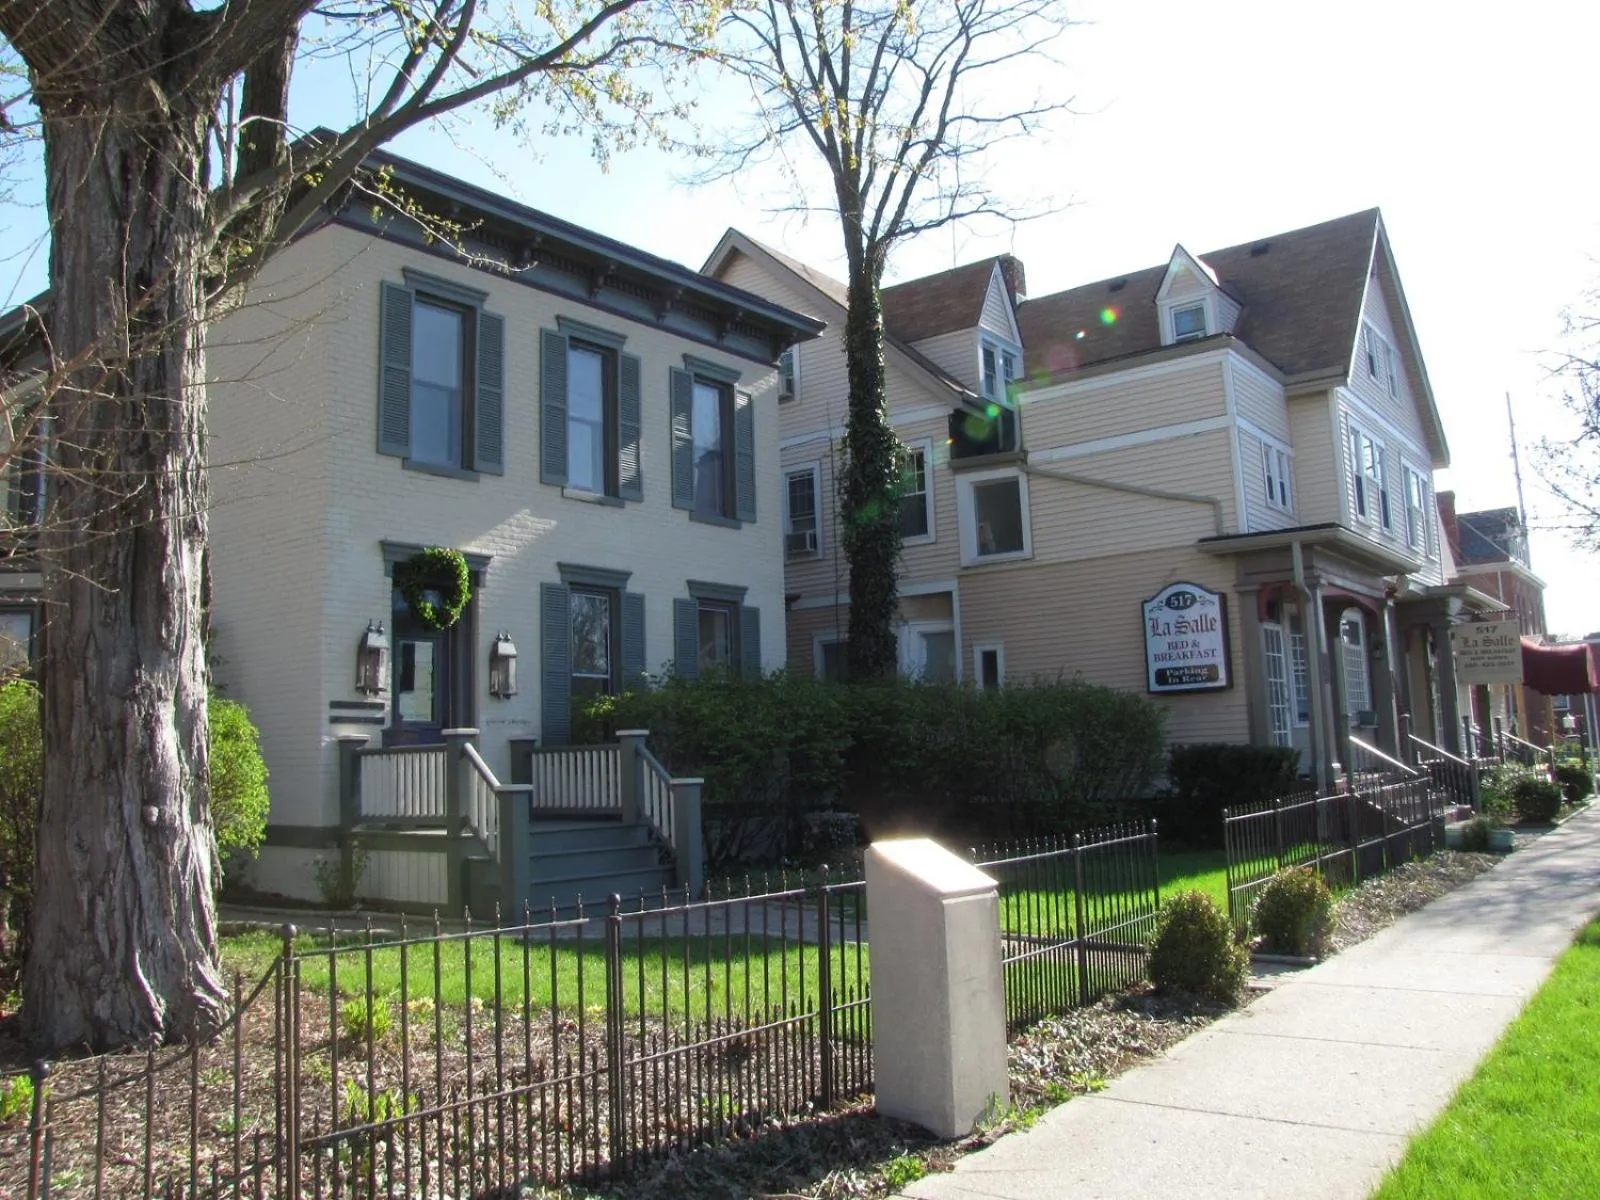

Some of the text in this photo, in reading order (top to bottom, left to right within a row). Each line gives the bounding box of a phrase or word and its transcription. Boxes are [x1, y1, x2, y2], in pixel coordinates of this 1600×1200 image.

[1170, 594, 1192, 607] 517
[1174, 613, 1217, 636] Salle
[1476, 625, 1498, 634] 517
[1167, 640, 1200, 651] BED &
[1482, 635, 1515, 647] Salle
[1153, 648, 1217, 662] BREAKFAST
[1166, 667, 1209, 677] Parking
